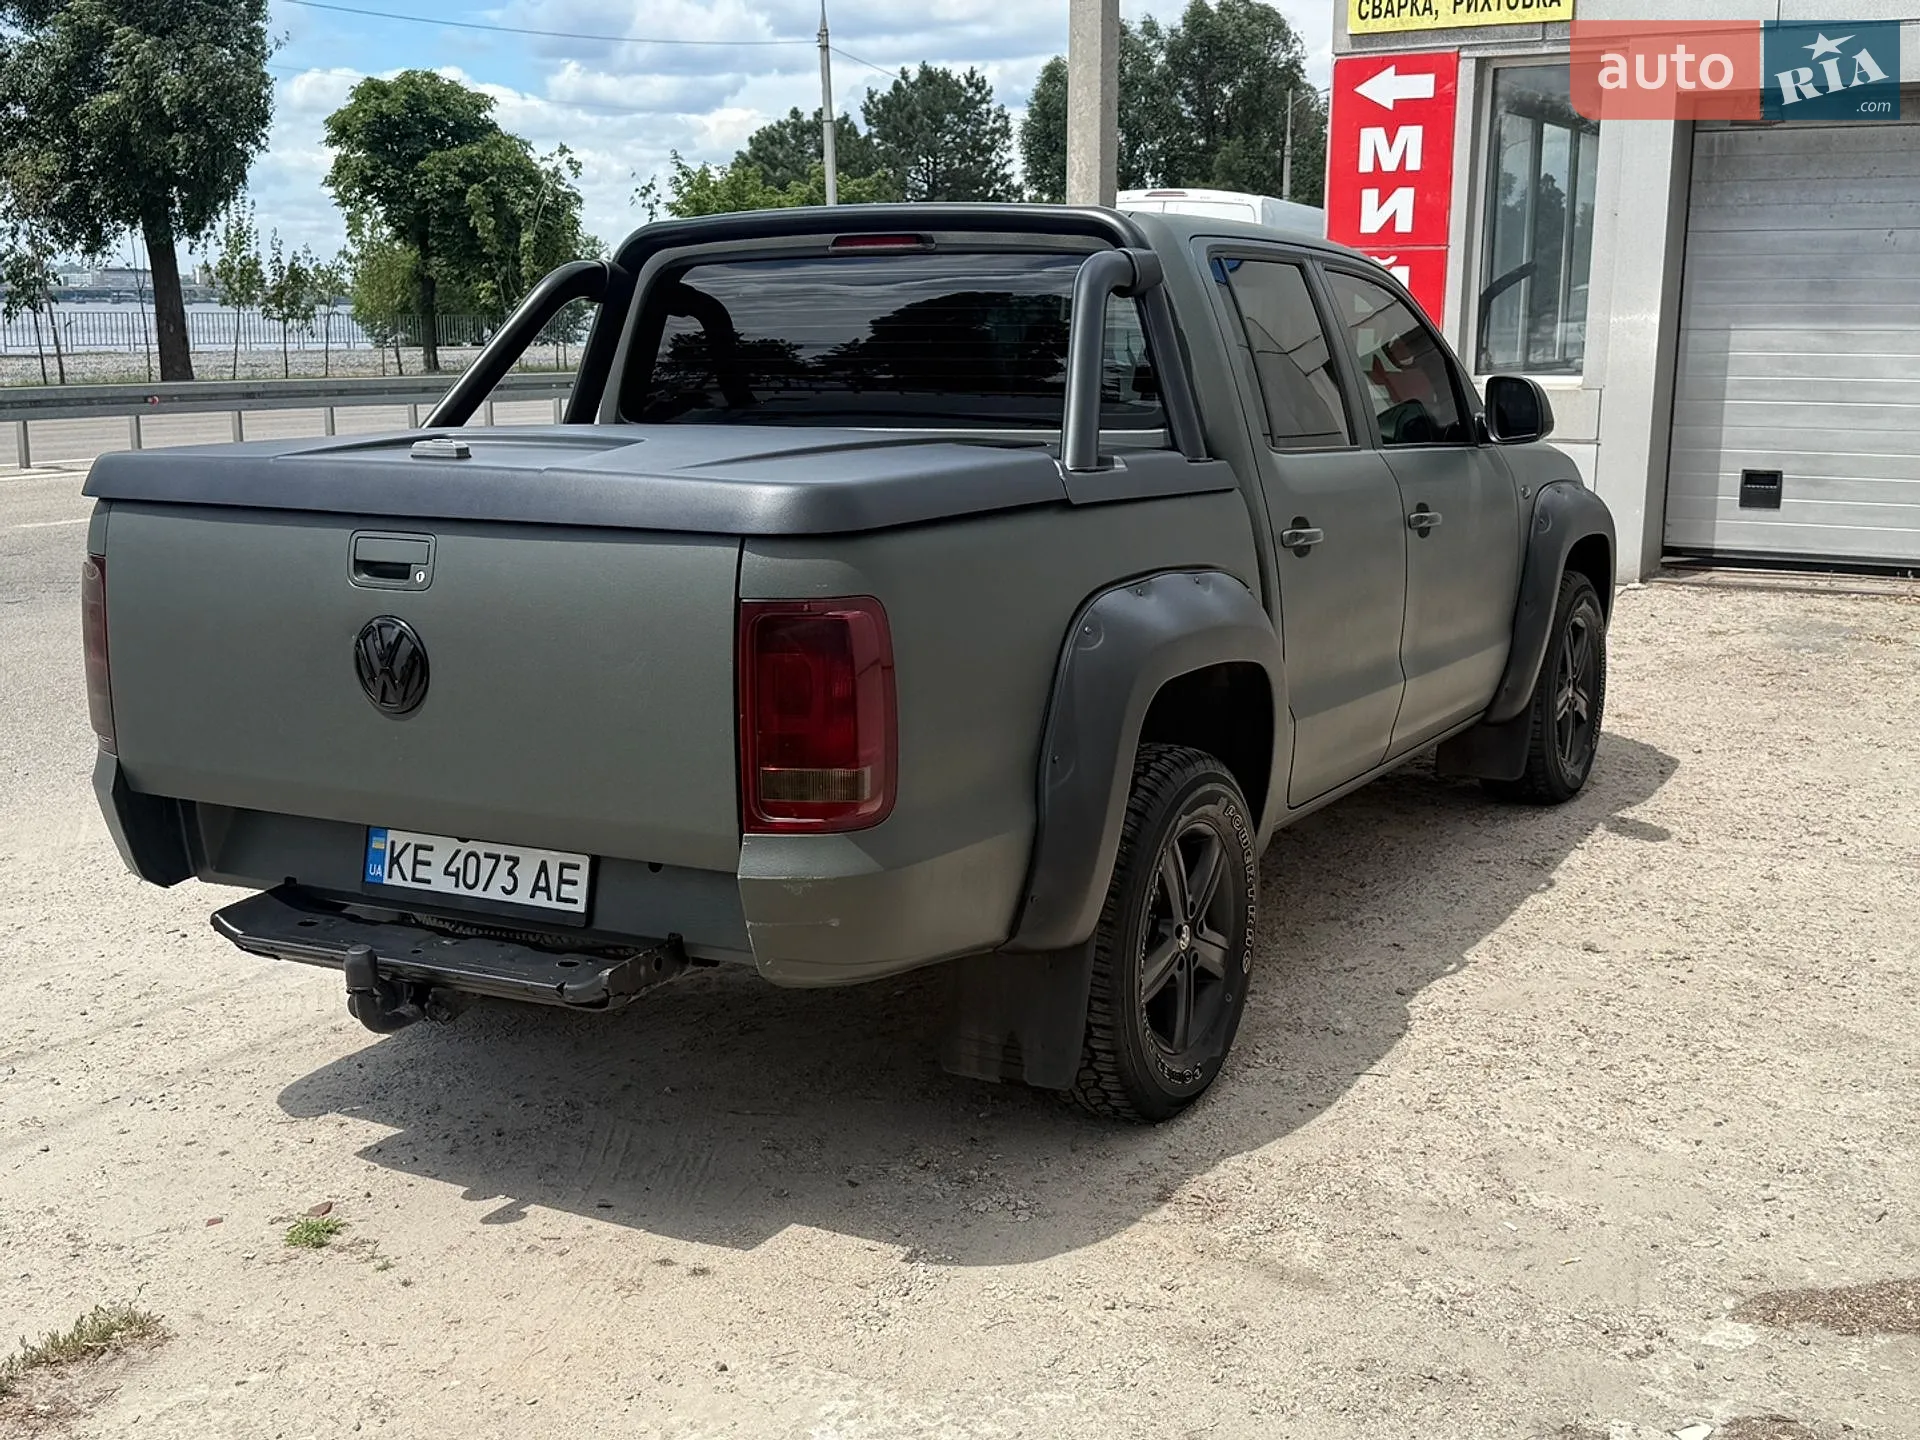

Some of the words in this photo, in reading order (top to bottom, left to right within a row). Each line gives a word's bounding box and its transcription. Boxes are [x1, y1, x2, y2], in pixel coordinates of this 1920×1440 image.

[369, 863, 382, 877] UA
[387, 840, 434, 885] KE
[443, 849, 520, 896] 4073
[529, 860, 581, 904] AE
